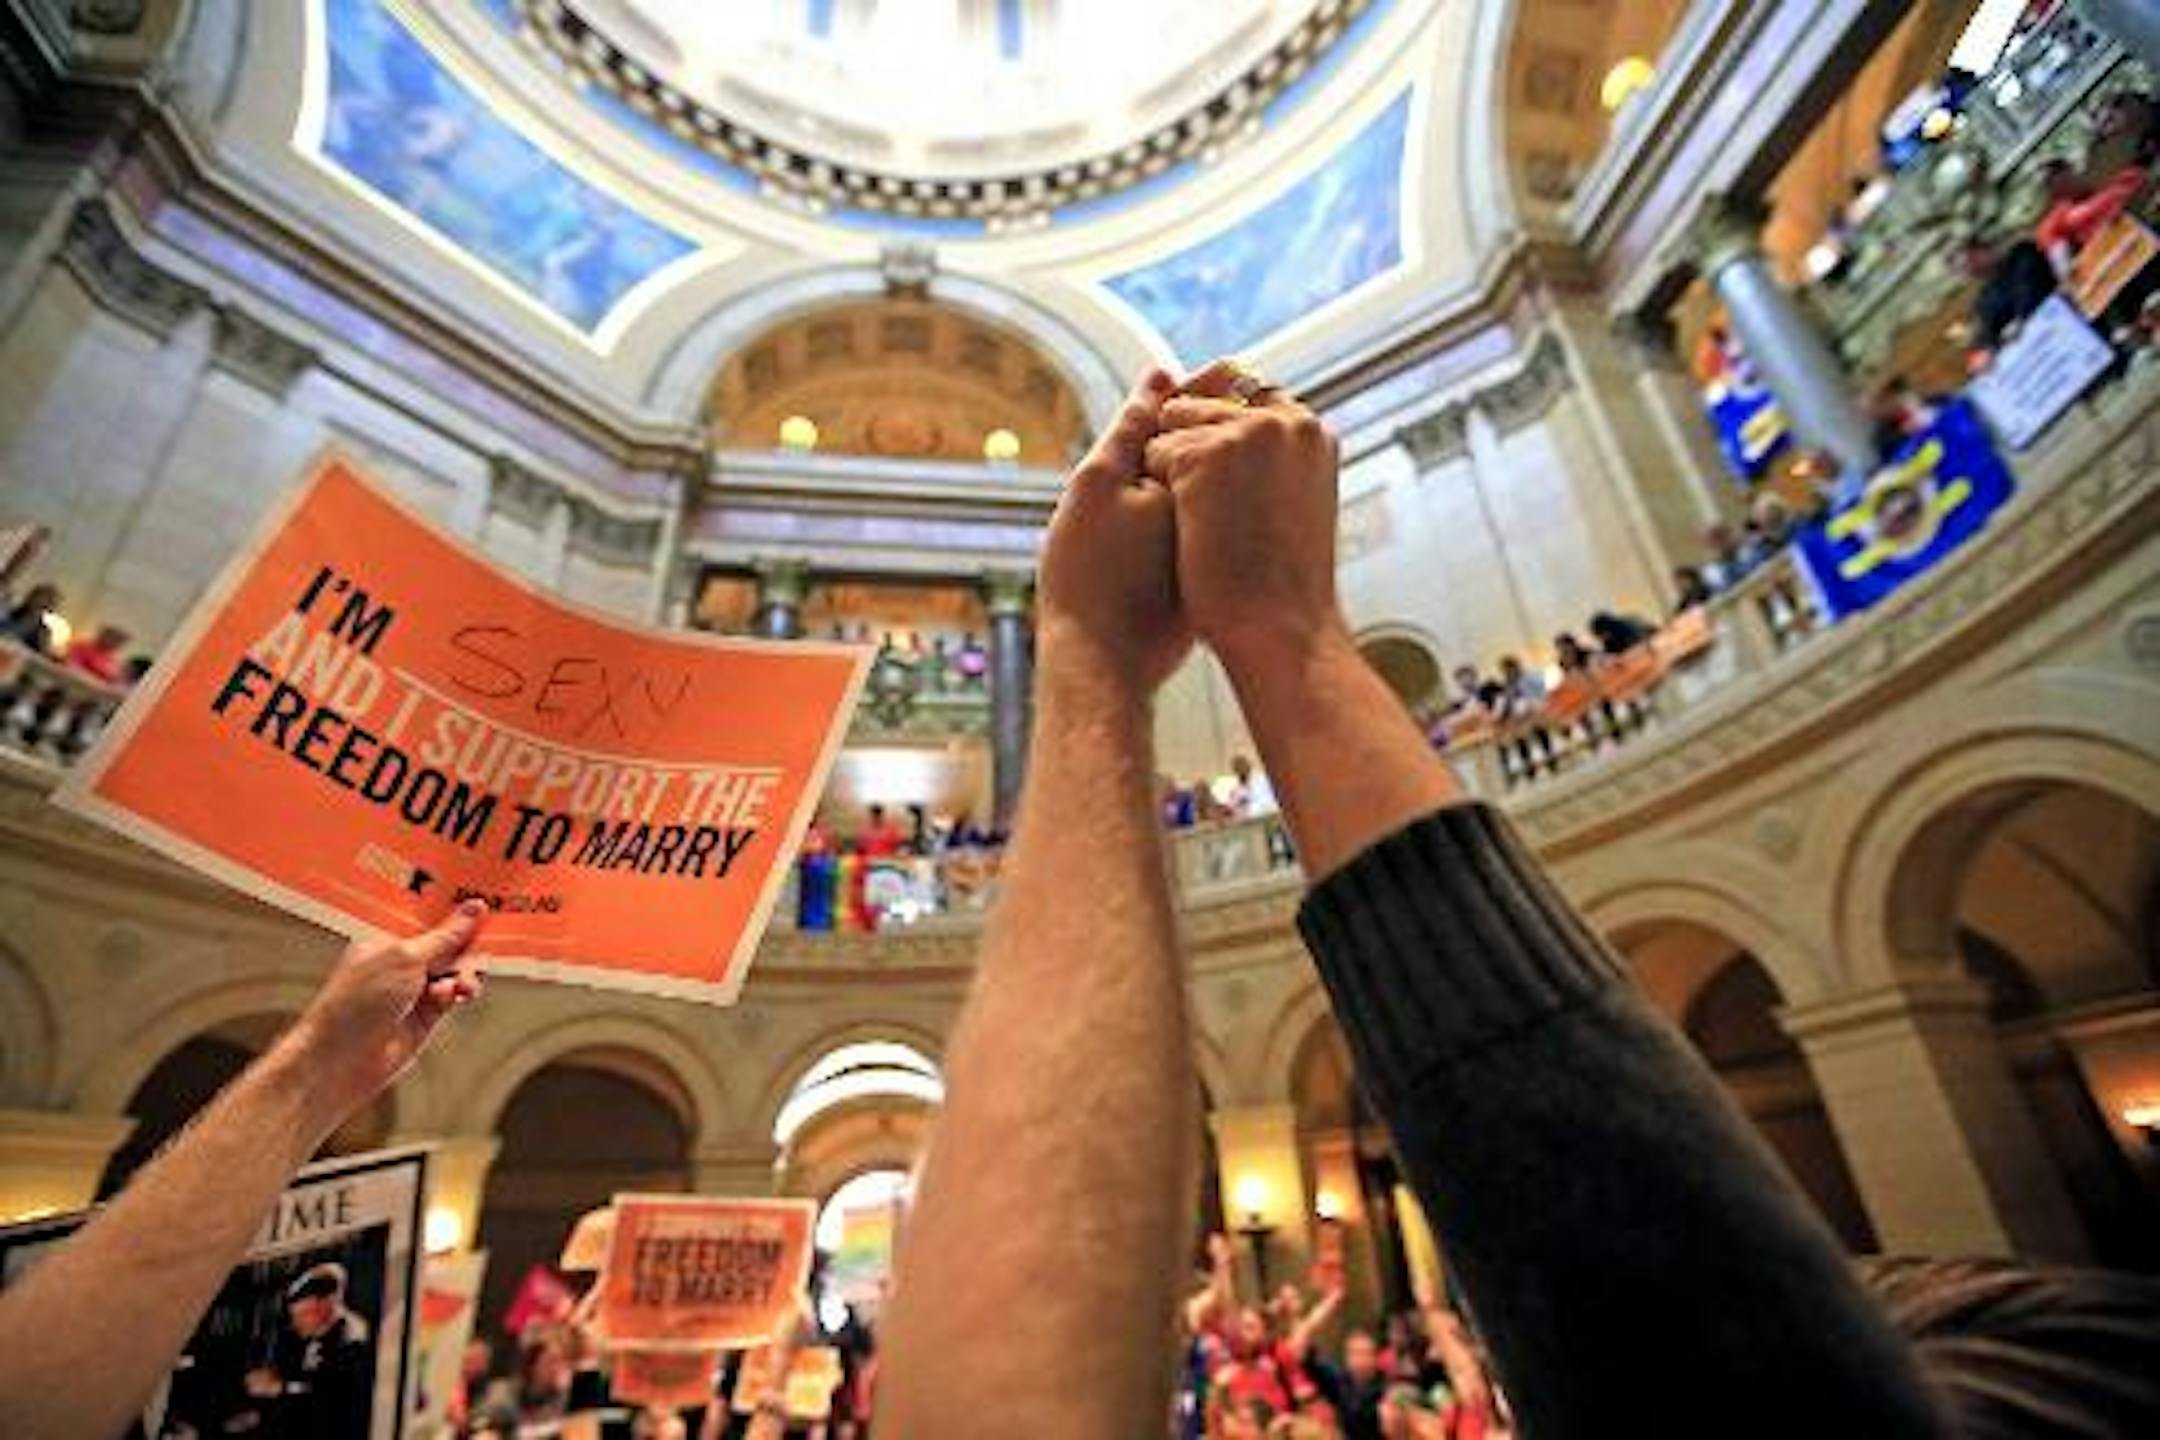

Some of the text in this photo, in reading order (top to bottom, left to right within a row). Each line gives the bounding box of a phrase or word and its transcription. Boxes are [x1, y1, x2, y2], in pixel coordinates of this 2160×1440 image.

[296, 566, 395, 656] I'M
[247, 612, 778, 832] AND I SUPPORT THE
[211, 657, 757, 878] FREEDOM TO MARRY
[268, 1189, 354, 1241] IME
[634, 1236, 784, 1276] FREEDOM
[673, 1275, 774, 1304] MARRY
